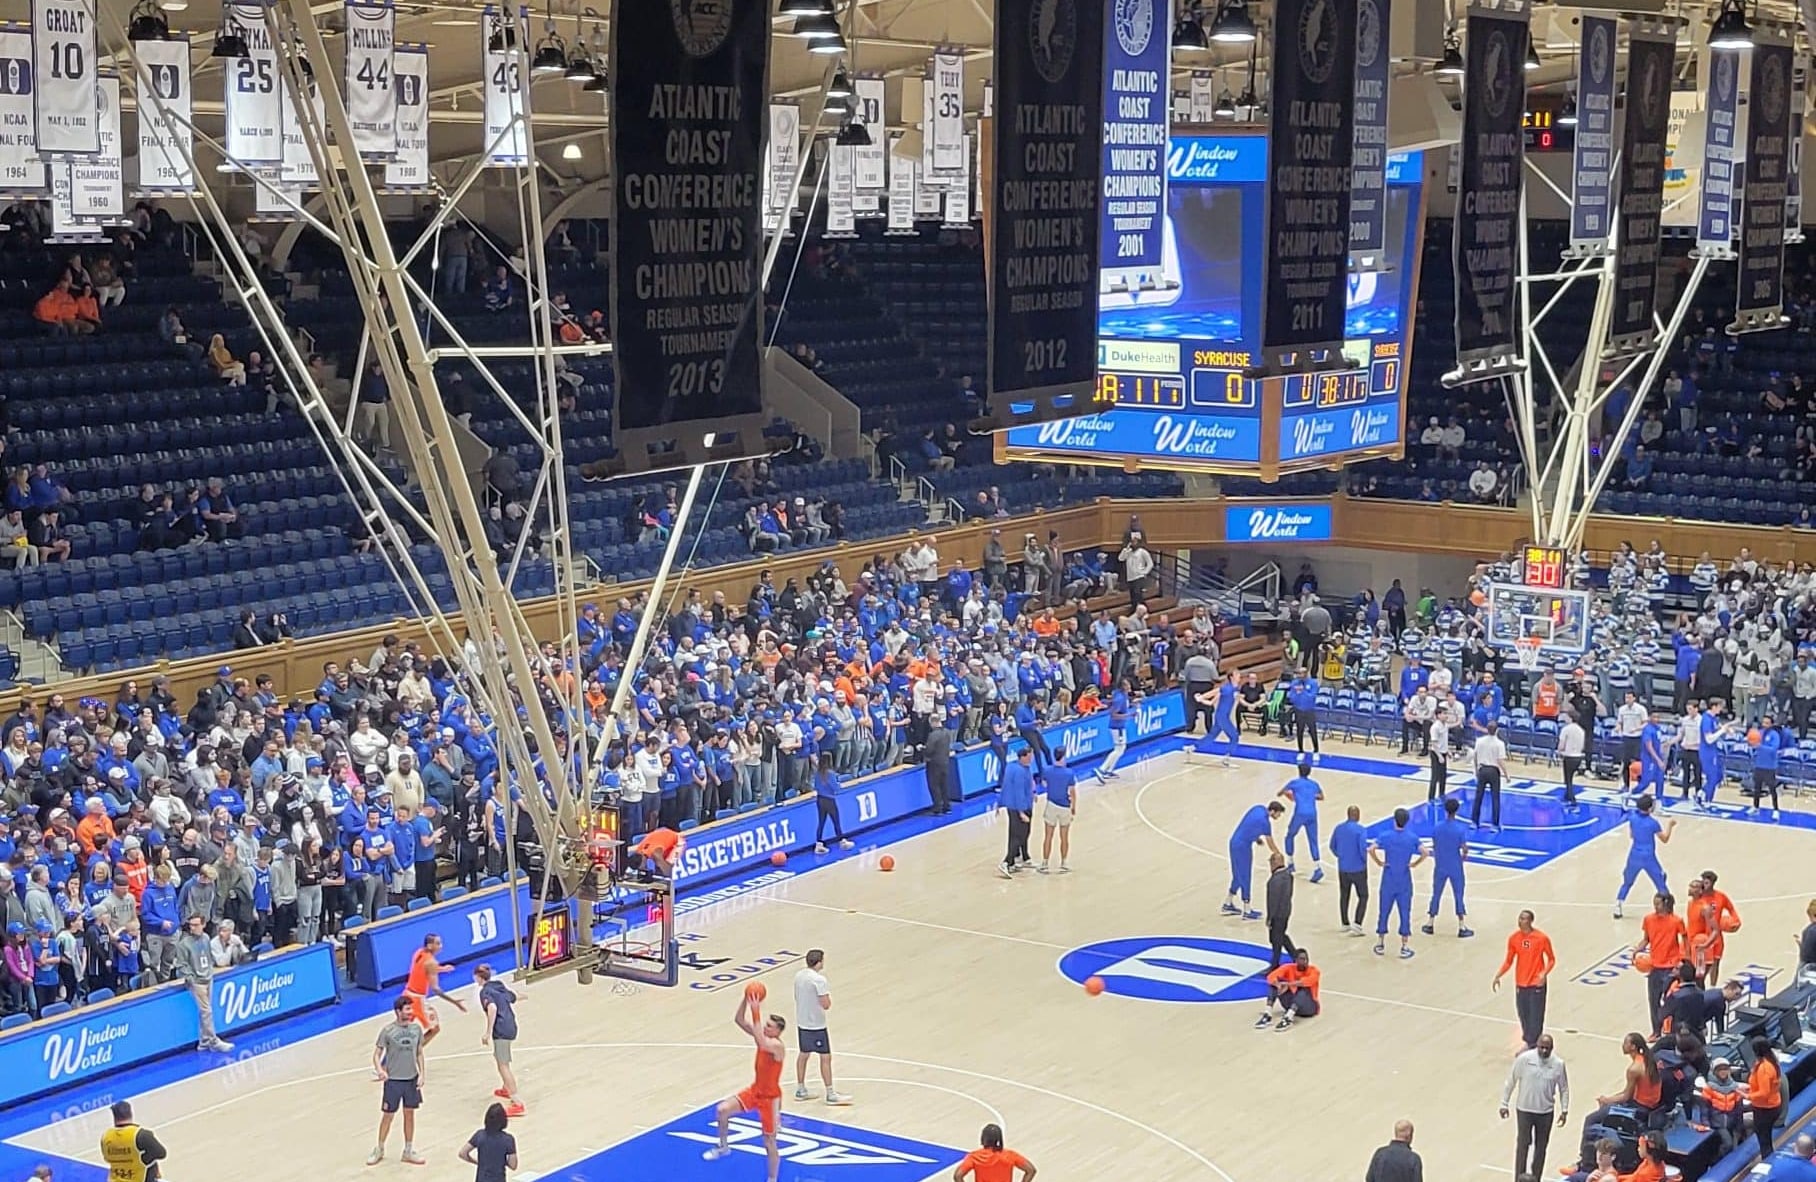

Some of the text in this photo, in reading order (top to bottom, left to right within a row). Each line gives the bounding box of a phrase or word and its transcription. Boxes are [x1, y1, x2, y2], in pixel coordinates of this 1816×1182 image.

[46, 9, 85, 33] GROAT
[50, 42, 84, 79] 10
[356, 57, 388, 90] 44
[237, 59, 273, 93] 25
[493, 62, 520, 93] 43
[1112, 69, 1158, 93] ATLANTIC
[648, 83, 742, 120] ATLANTIC
[939, 93, 960, 118] 35
[1119, 96, 1151, 119] COAST
[1289, 101, 1342, 128] ATLANTIC
[4, 114, 28, 126] NCAA
[1015, 104, 1086, 135] ATLANTIC
[17, 135, 36, 146] FOU
[666, 129, 732, 165] COAST
[1104, 122, 1164, 145] CONFERENCE
[1295, 133, 1333, 160] COAST
[1025, 142, 1076, 173] COAST
[1111, 149, 1157, 171] WOMEN'S
[6, 166, 27, 178] 1964
[76, 169, 119, 180] CHAMPIONS
[1277, 166, 1350, 192] CONFERENCE
[625, 173, 755, 209] CONFERENCE
[1003, 181, 1095, 211] CONFERENCE
[1104, 175, 1161, 197] CHAMPIONS
[88, 196, 109, 207] 1960
[650, 218, 743, 254] WOMEN'S
[1014, 217, 1083, 249] WOMEN'S
[1118, 234, 1144, 257] 2001
[1277, 230, 1345, 257] CHAMPIONS
[1006, 254, 1089, 288] CHAMPIONS
[647, 306, 699, 329] REGULAR
[1292, 301, 1323, 331] 2011
[1024, 338, 1067, 372] 2012
[1111, 350, 1176, 364] DukeHealth
[1194, 350, 1251, 367] SYRACUSE
[669, 359, 725, 397] 2013
[1226, 373, 1243, 402] 0
[1301, 373, 1312, 400] 0
[1384, 362, 1394, 390] 0
[1526, 564, 1555, 585] 30
[541, 934, 559, 957] 30
[690, 950, 801, 990] COURT
